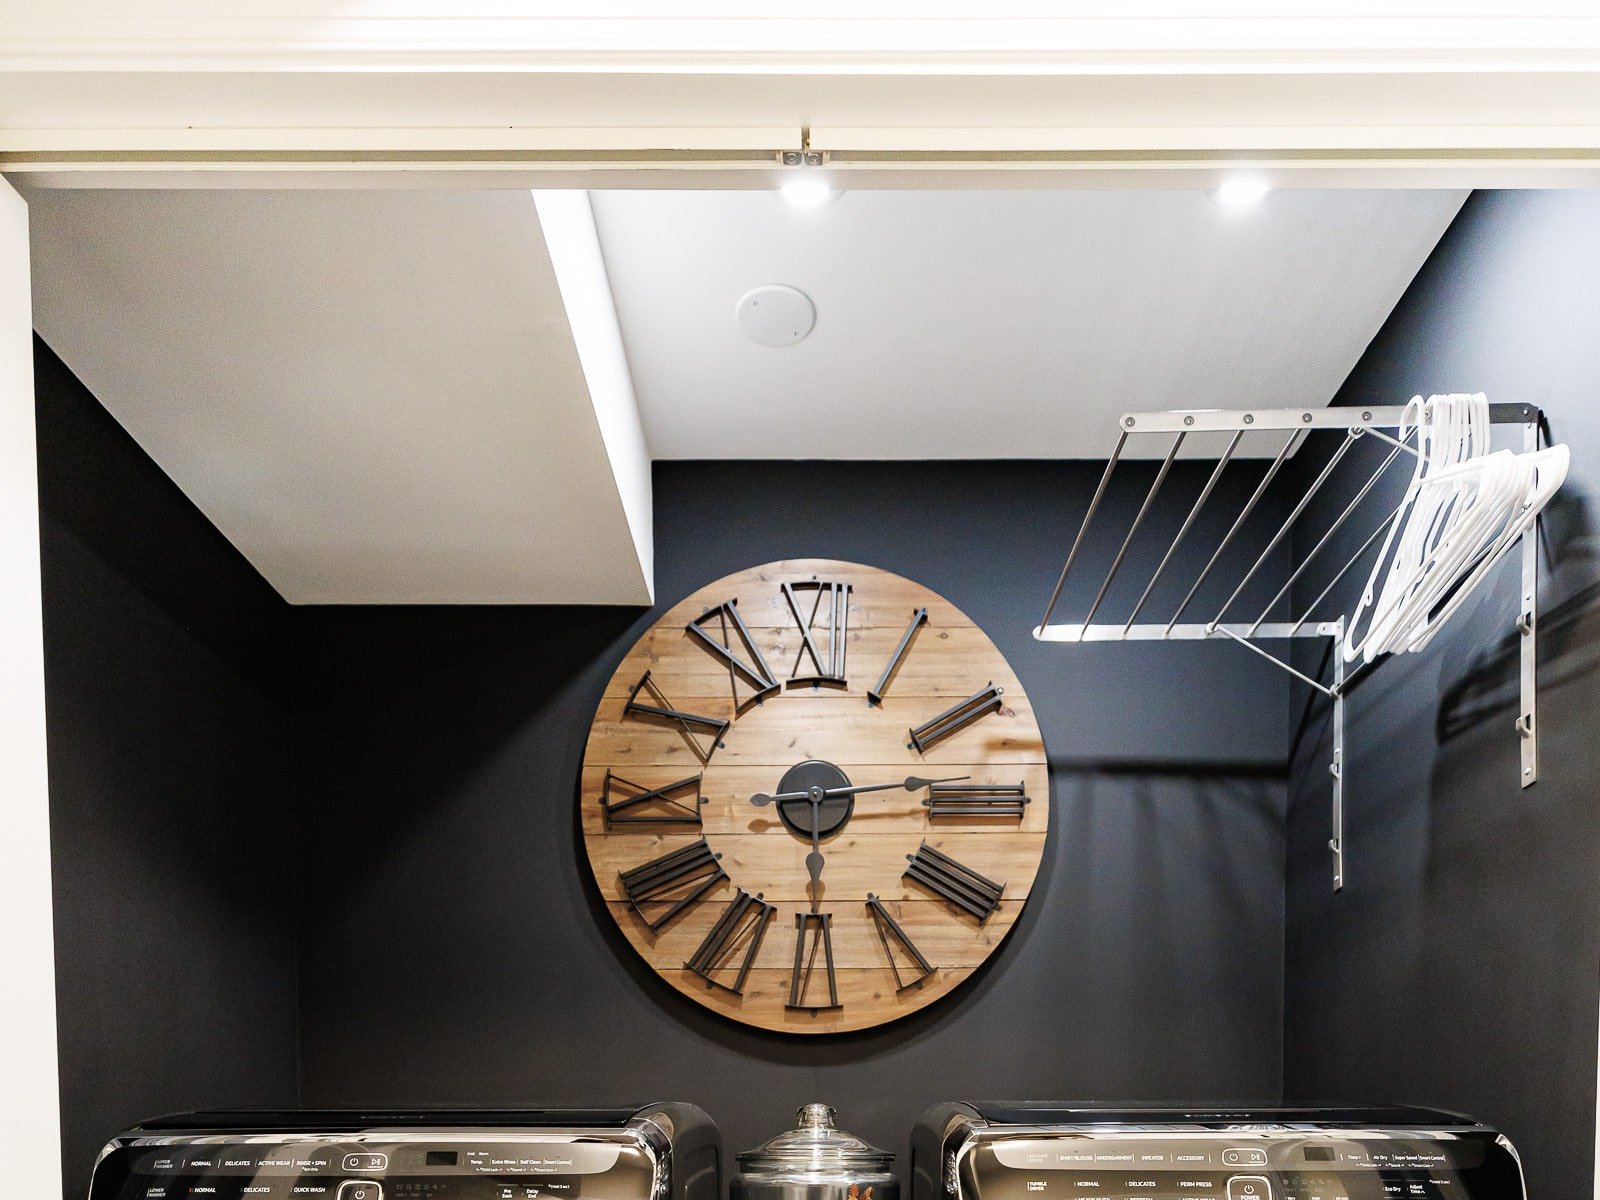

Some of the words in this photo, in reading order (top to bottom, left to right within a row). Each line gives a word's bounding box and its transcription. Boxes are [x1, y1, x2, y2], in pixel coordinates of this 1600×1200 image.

[686, 599, 781, 720] XI
[781, 581, 852, 690] XII
[868, 608, 927, 706] I
[623, 671, 730, 766] X
[909, 681, 1004, 753] II
[604, 768, 703, 831] IX
[928, 781, 1024, 819] III
[617, 835, 730, 935] VIII
[901, 838, 1006, 926] IIII
[683, 887, 776, 996] VII
[785, 913, 844, 1011] VI
[866, 893, 938, 993] V
